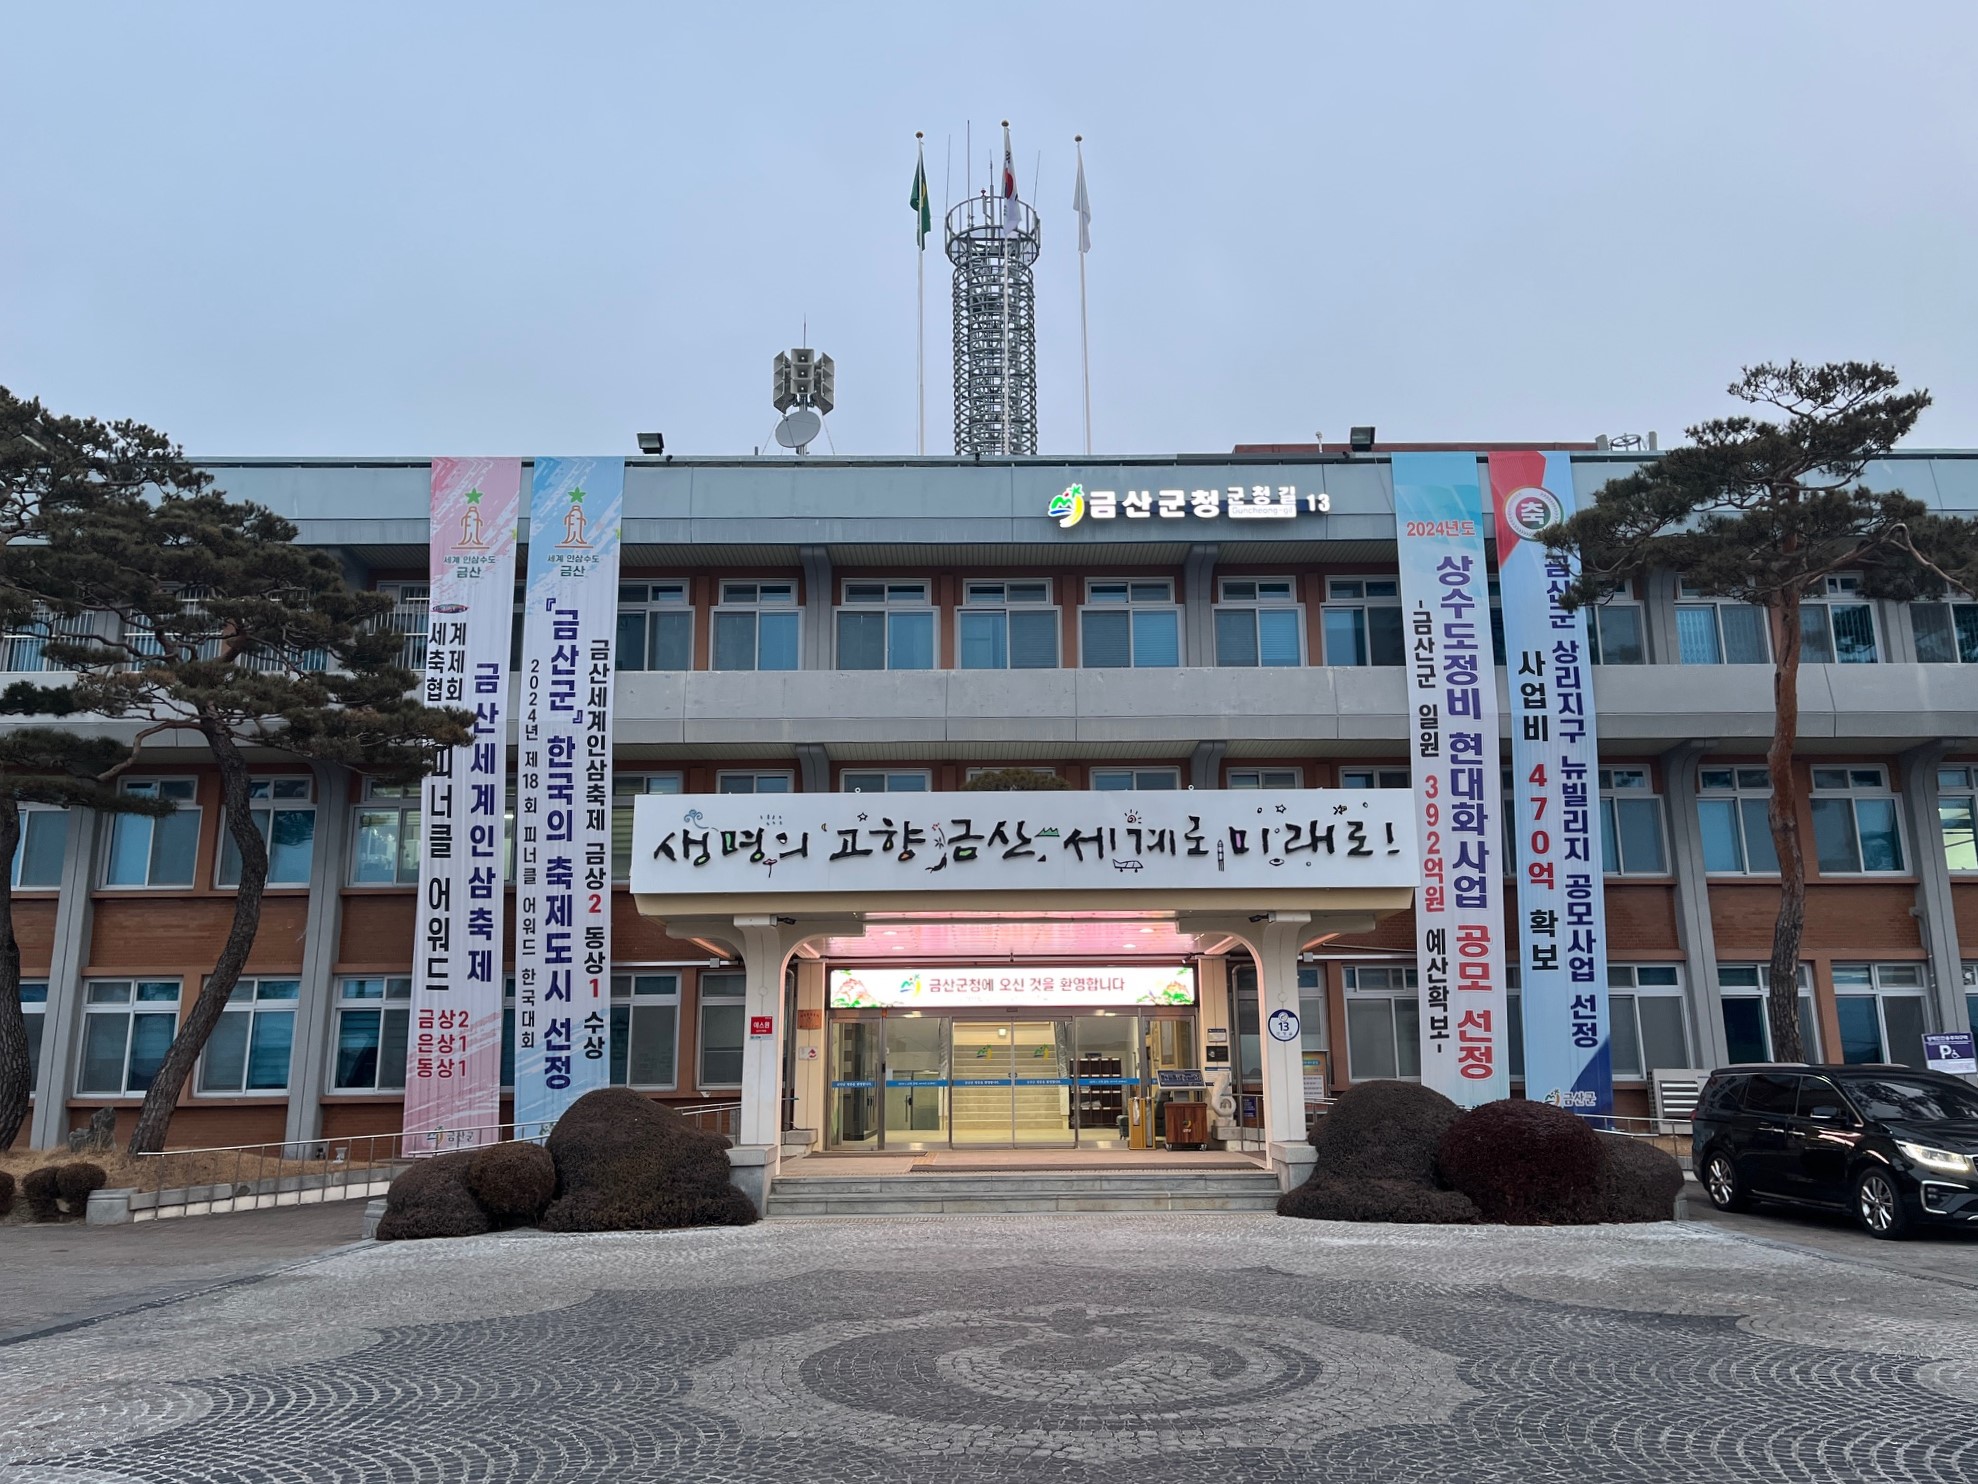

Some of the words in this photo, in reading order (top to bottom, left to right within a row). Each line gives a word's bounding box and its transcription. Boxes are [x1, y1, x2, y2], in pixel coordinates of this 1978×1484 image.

[1089, 489, 1220, 518] 금산군청
[1227, 486, 1297, 505] 군청길
[1307, 494, 1331, 512] 13
[1520, 502, 1545, 525] 축
[547, 554, 564, 563] 세계
[566, 554, 600, 563] 인삼수도
[1407, 520, 1476, 538] 2024년도
[443, 555, 460, 564] 세계
[463, 555, 496, 564] 인삼수도
[456, 566, 482, 578] 금산
[560, 565, 586, 577] 금산
[428, 649, 465, 674] 축제
[429, 622, 467, 646] 세계
[1436, 555, 1483, 720] 상수도정비
[426, 677, 463, 701] 협회
[525, 659, 540, 741] 2024년
[1518, 651, 1550, 742] 사업비
[1551, 639, 1588, 743] 상리지구
[586, 639, 610, 831] 금산세계인삼축제
[1418, 704, 1440, 758] 일원
[546, 735, 576, 842] 한국의
[1560, 755, 1589, 862] 뉴빌리지
[467, 663, 499, 982] 금산세계인삼축제
[654, 828, 809, 867] 생명의
[829, 817, 926, 861] 고향
[1063, 815, 1210, 861] 세계로
[1228, 820, 1401, 856] 미래로!
[1423, 774, 1446, 912] 392억원
[1449, 732, 1490, 909] 현대화사업
[1528, 763, 1555, 890] 470억
[523, 825, 538, 885] 피너클
[584, 842, 606, 914] 금상2
[425, 877, 451, 990] 어워드
[522, 897, 537, 956] 어워드
[545, 856, 574, 1002] 축제도시
[1530, 909, 1559, 971] 확보
[1565, 874, 1597, 983] 공모사업
[584, 926, 606, 998] 동상1
[929, 978, 994, 993] 금산군청에
[999, 978, 1025, 992] 오신
[1029, 977, 1055, 992] 것을
[1060, 977, 1125, 992] 환영합니다
[1456, 924, 1494, 993] 공모
[418, 1009, 469, 1029] 금상2
[521, 968, 536, 1049] 한국대회
[583, 1011, 605, 1060] 수상
[1278, 1022, 1290, 1031] 13
[1570, 994, 1599, 1049] 선정
[416, 1058, 467, 1078] 동상1
[417, 1033, 467, 1053] 은상1
[544, 1017, 572, 1089] 선정
[1457, 1009, 1495, 1080] 선정
[1939, 1045, 1952, 1059] P
[1563, 1091, 1597, 1106] 금산군
